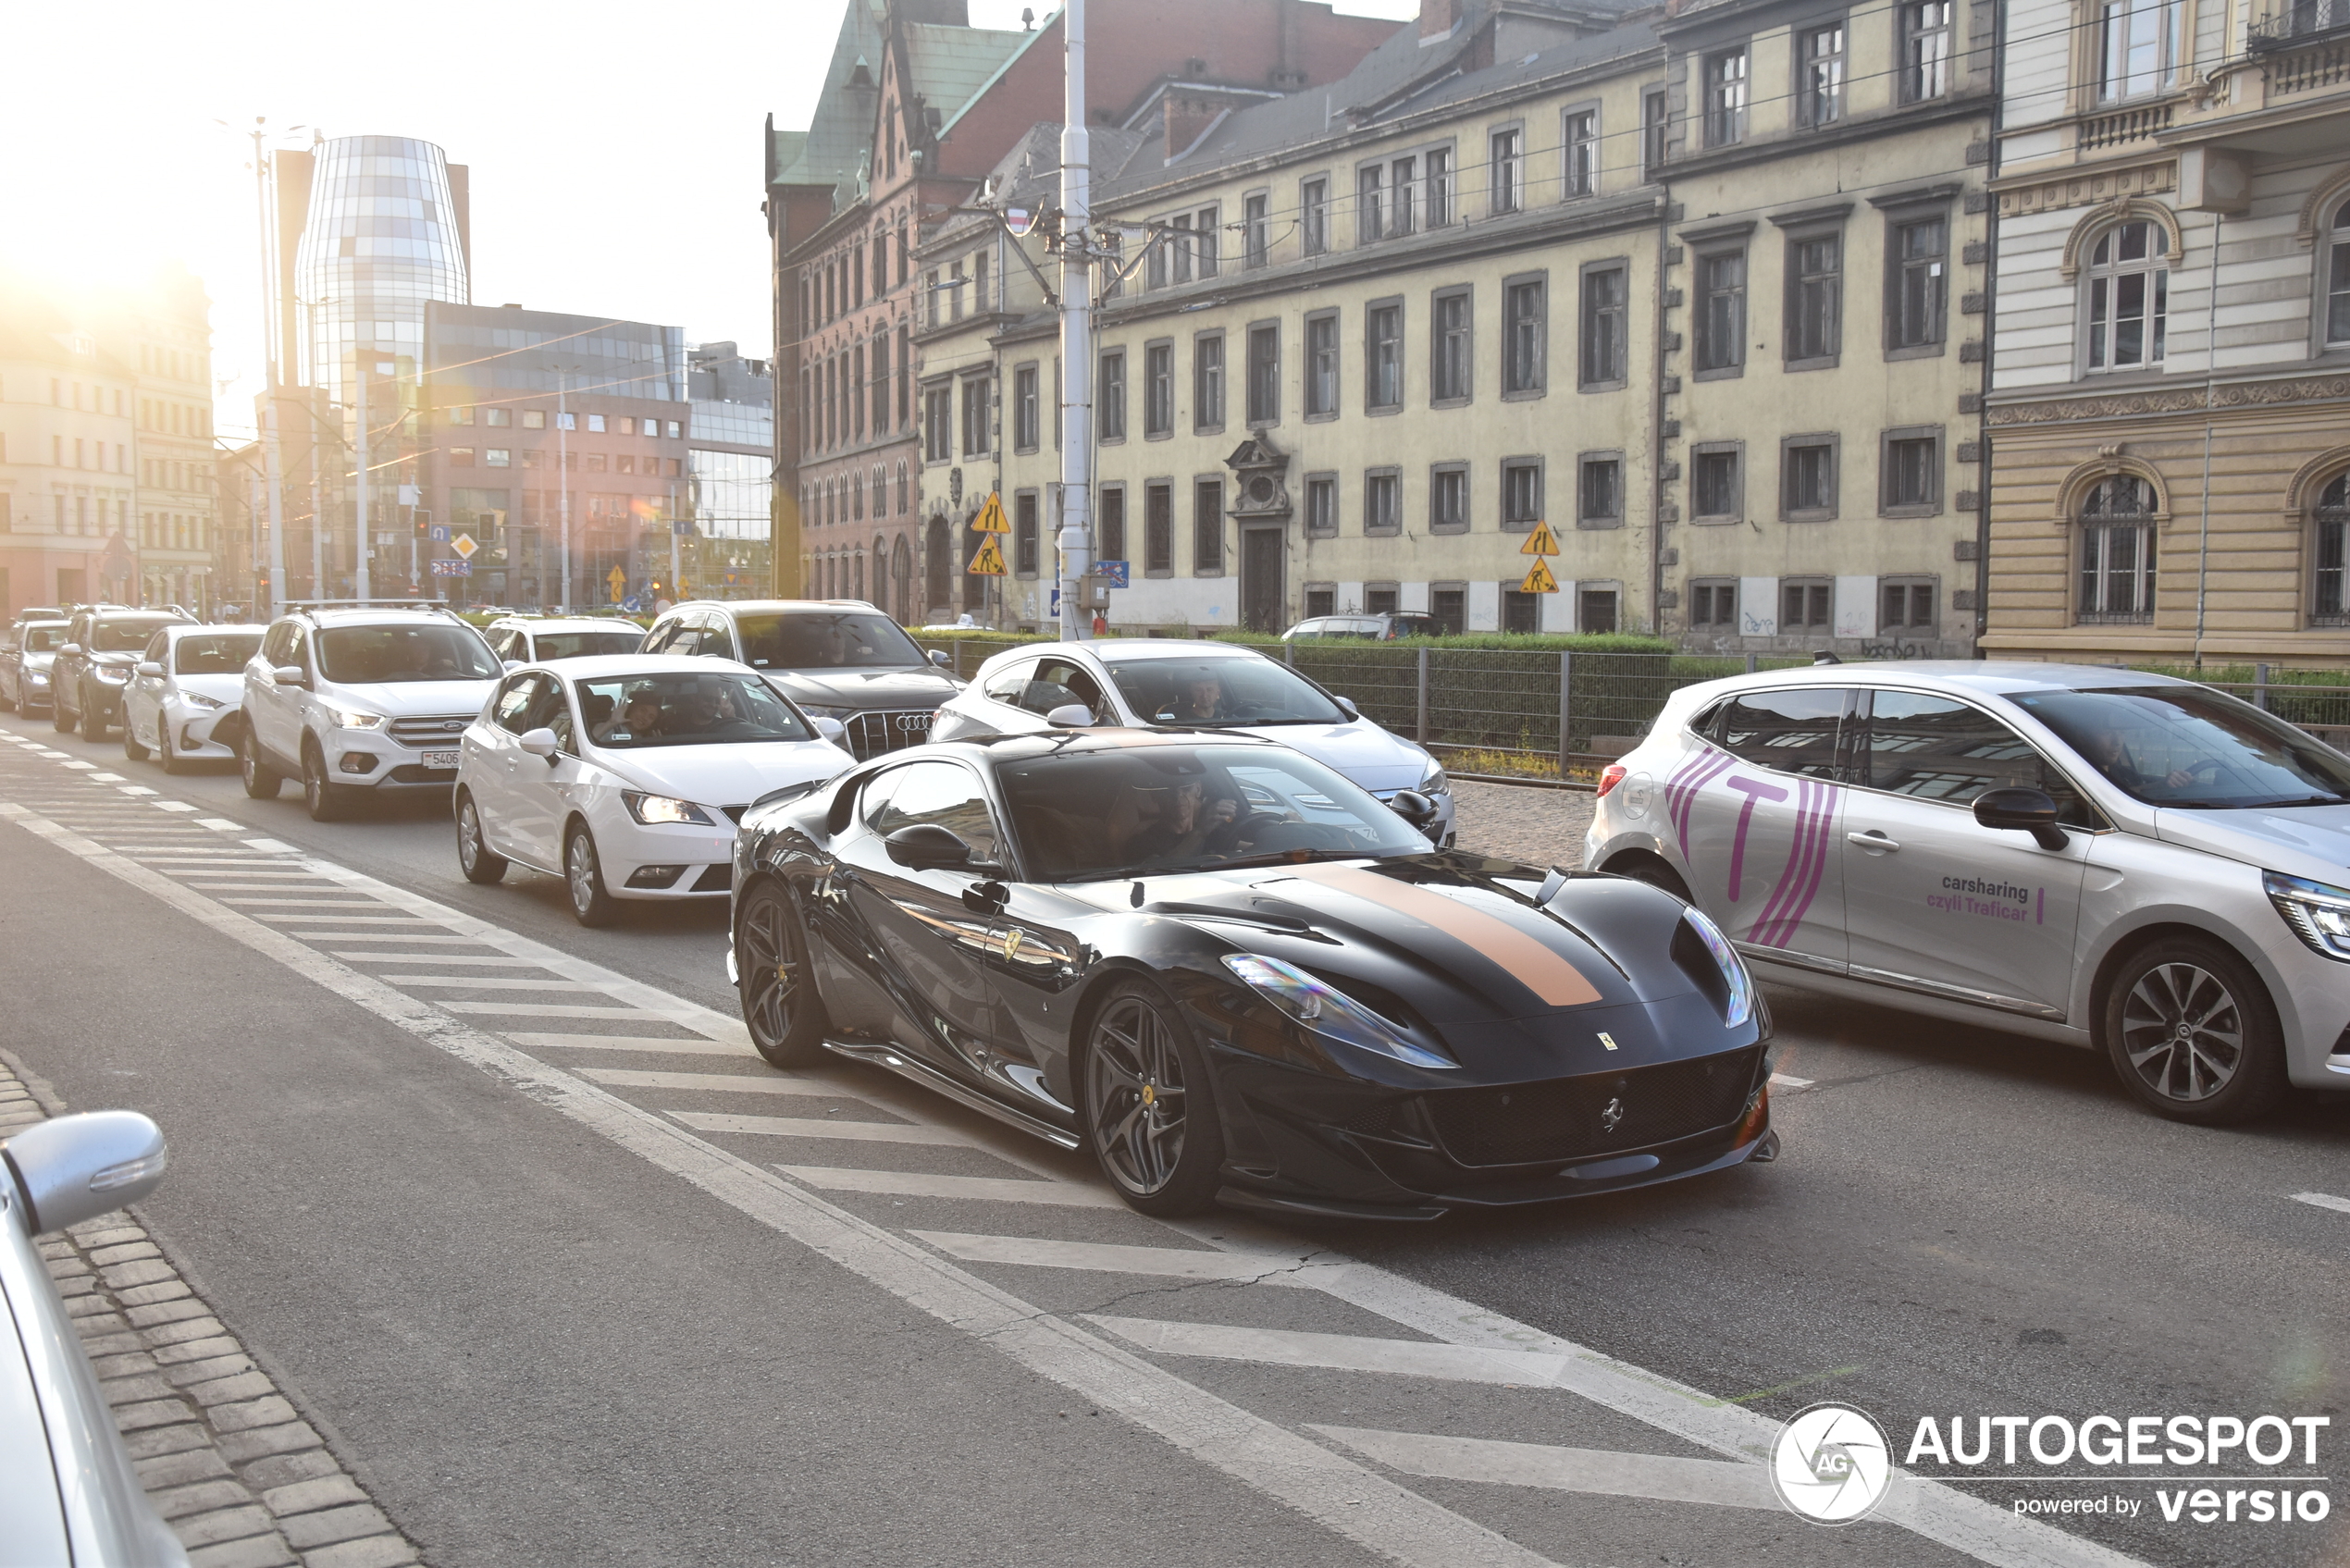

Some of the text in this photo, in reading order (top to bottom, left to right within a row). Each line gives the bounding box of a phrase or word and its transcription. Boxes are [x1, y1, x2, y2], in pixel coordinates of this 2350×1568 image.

[433, 753, 459, 765] 5406
[1942, 876, 2028, 904] carsharing
[1926, 895, 2028, 921] czyli Traficar
